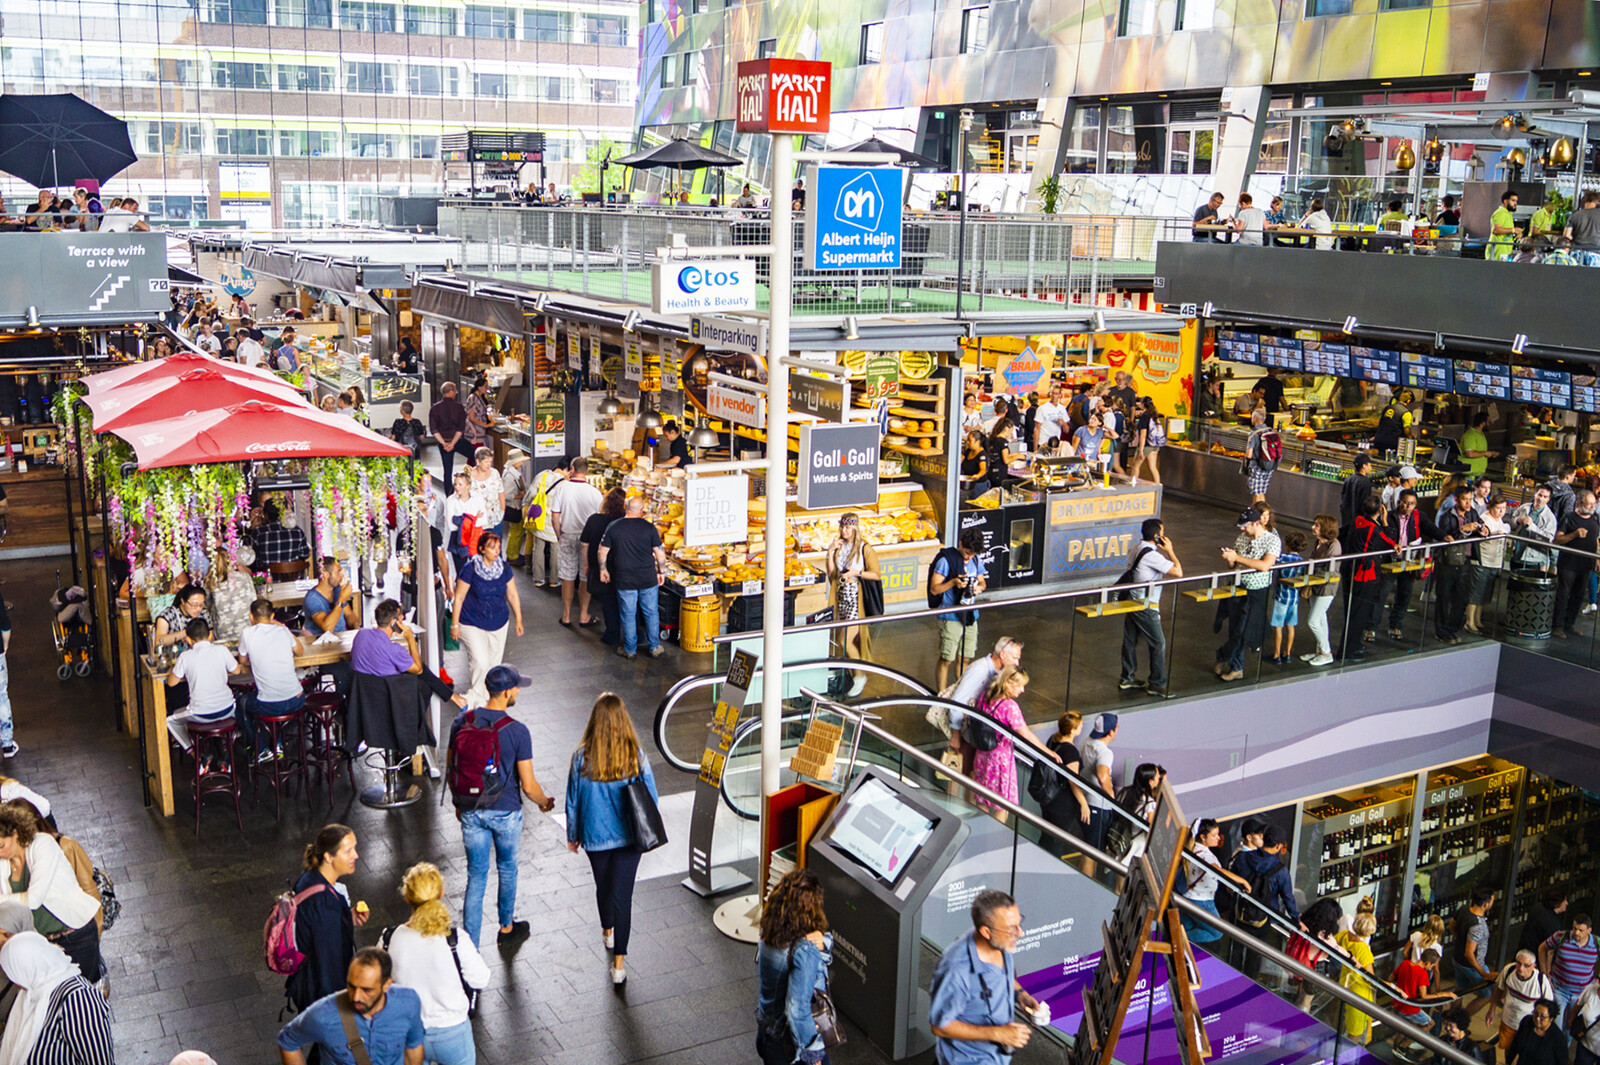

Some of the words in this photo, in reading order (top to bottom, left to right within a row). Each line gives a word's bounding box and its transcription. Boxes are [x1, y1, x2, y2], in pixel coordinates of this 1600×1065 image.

[739, 73, 767, 92] MARKT
[772, 73, 826, 92] MARKT
[741, 94, 762, 122] HAL
[777, 94, 818, 123] HAL
[821, 232, 860, 246] Albert
[864, 232, 895, 248] Heijn
[67, 245, 115, 256] Terrace
[118, 244, 145, 255] with
[822, 249, 894, 266] Supermarkt
[86, 259, 95, 268] a
[98, 257, 130, 268] view
[150, 280, 168, 290] 70
[677, 266, 740, 294] etos
[667, 298, 701, 308] Health
[704, 297, 711, 306] &
[714, 296, 749, 307] Beauty
[701, 322, 758, 352] Interparking
[1010, 360, 1042, 372] BRAM
[722, 395, 756, 415] vendor
[245, 441, 311, 453] Coca-Cola
[813, 473, 838, 484] Wines
[848, 470, 874, 482] Spirits
[696, 486, 716, 501] DE
[695, 500, 731, 516] TIJD
[1057, 503, 1094, 518] BRAM
[1099, 497, 1148, 513] LADAGE
[695, 514, 736, 531] TRAP
[1068, 534, 1132, 562] PATAT
[948, 881, 965, 892] 2001
[1063, 954, 1079, 965] 1965
